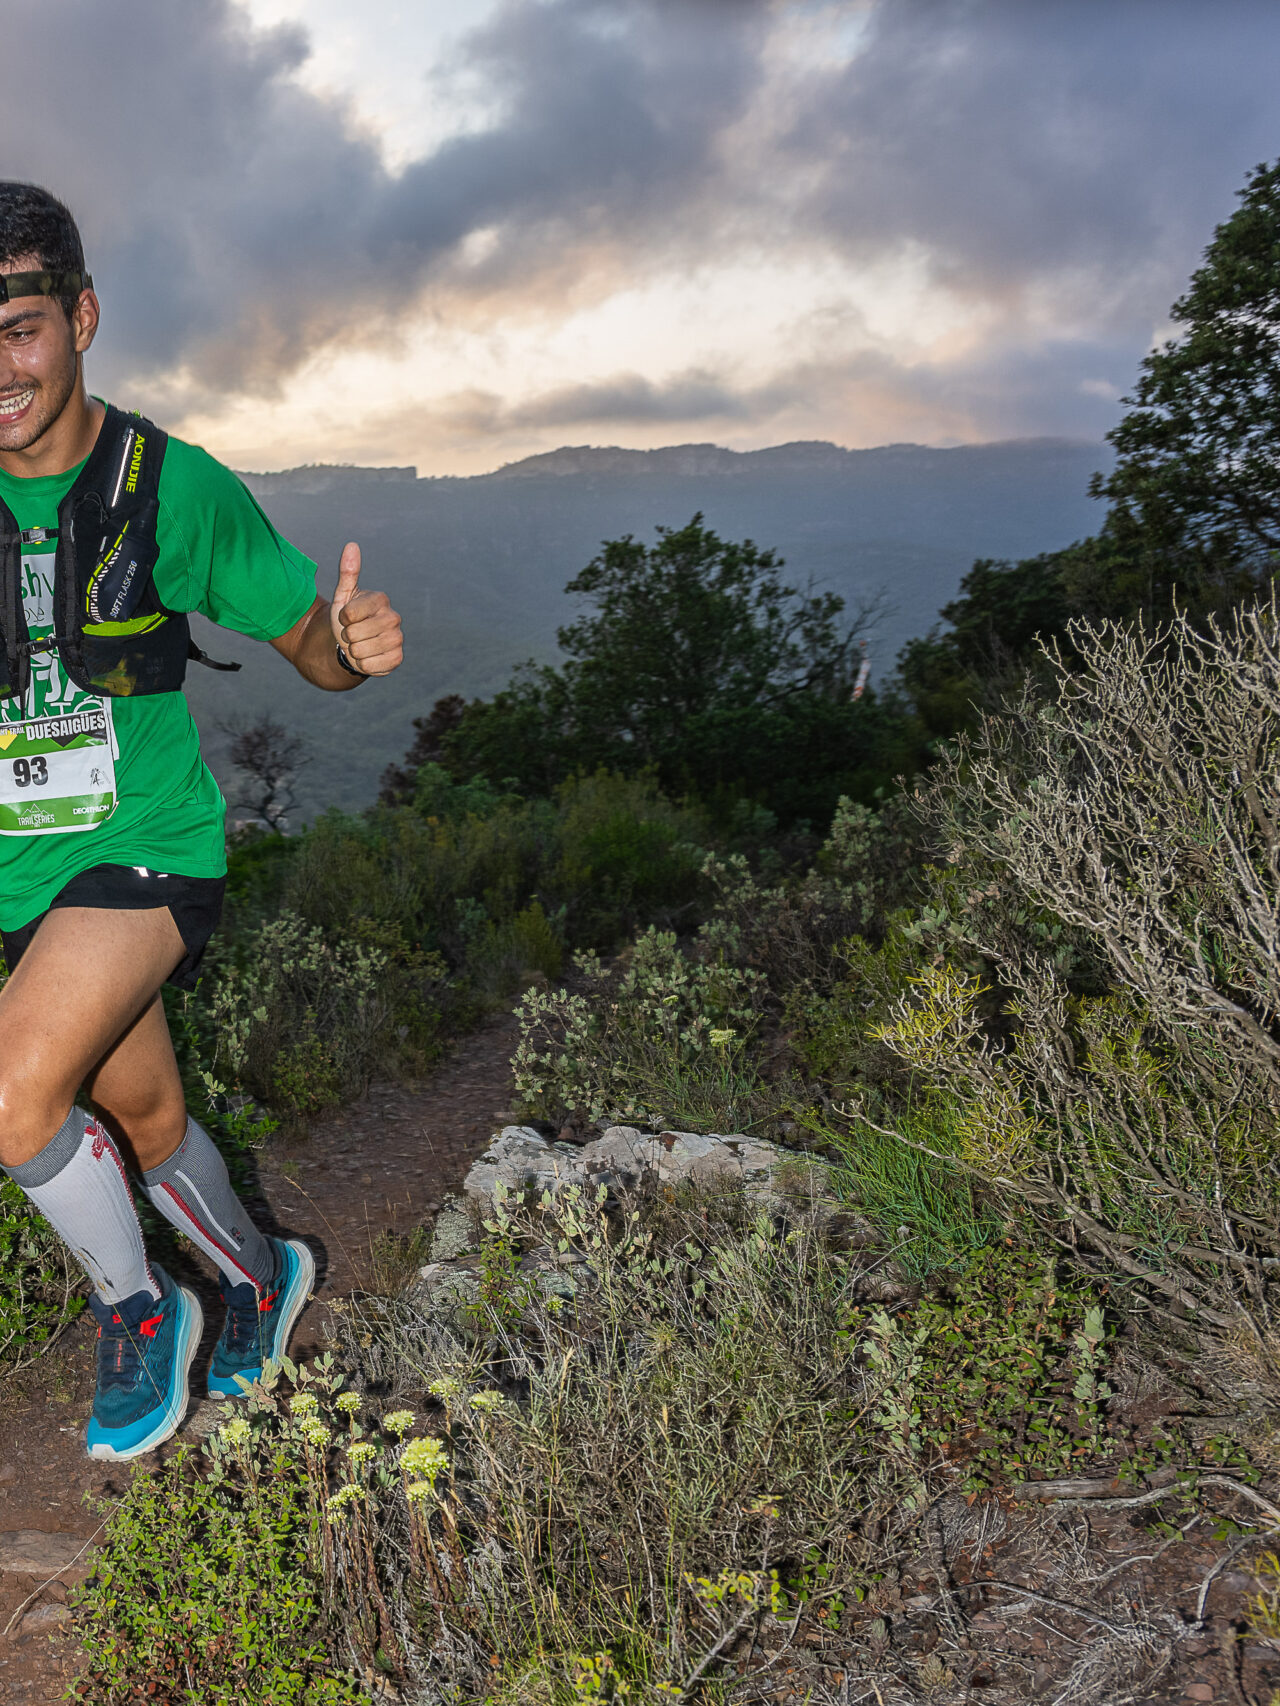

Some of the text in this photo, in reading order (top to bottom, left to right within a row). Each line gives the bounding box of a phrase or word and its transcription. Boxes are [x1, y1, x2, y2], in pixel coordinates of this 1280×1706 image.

[125, 433, 145, 493] AONIJIE
[110, 560, 138, 618] SOFT FLASK 250
[25, 713, 106, 741] DUESAIGÜES
[12, 756, 49, 788] 93
[72, 804, 110, 815] DECATHLON
